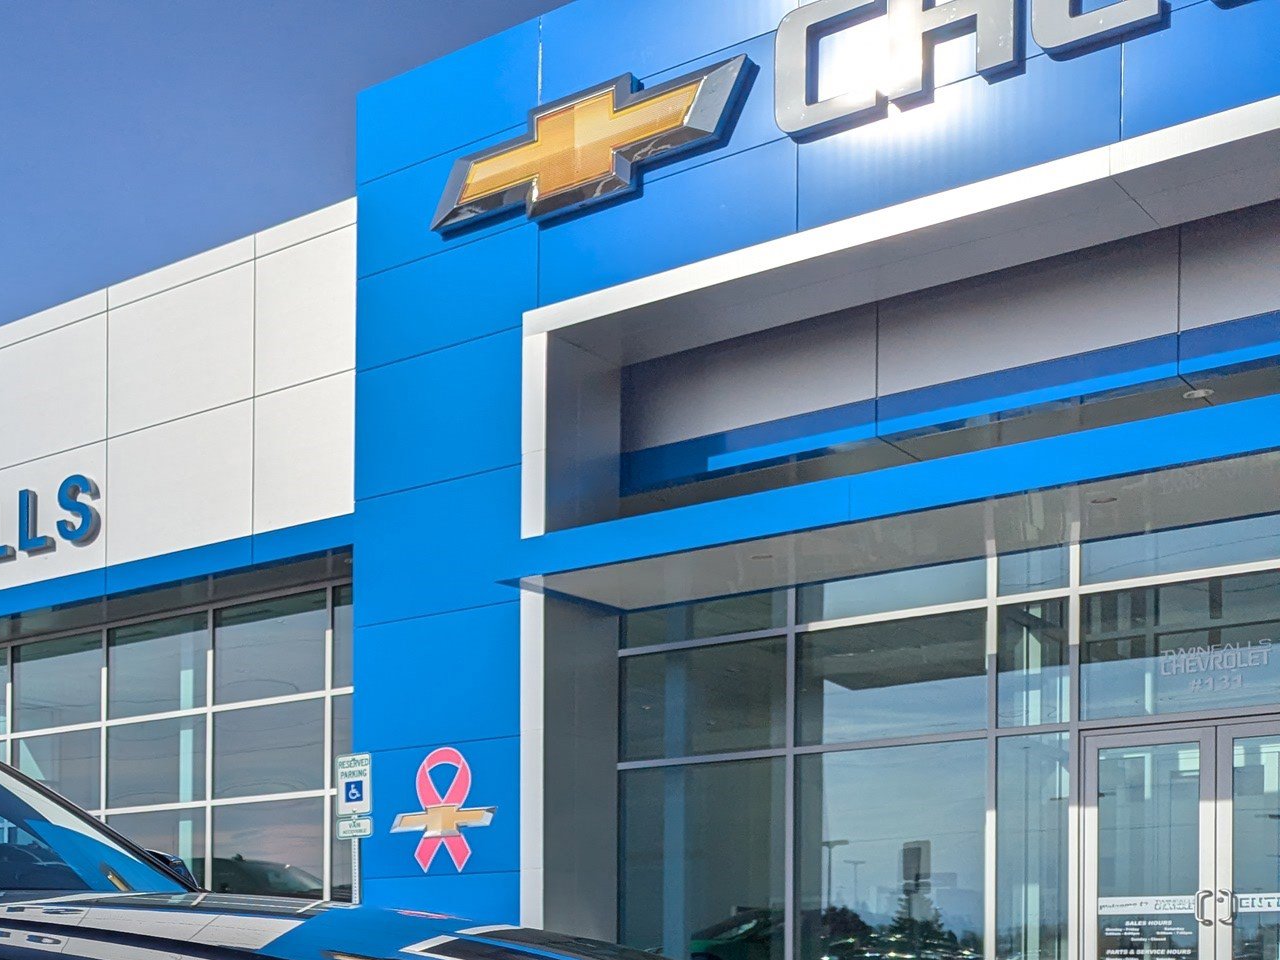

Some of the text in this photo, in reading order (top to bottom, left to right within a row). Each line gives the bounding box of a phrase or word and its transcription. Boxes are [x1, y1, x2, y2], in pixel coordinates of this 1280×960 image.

[1160, 648, 1272, 676] CHEVROLET
[1191, 674, 1243, 692] #131
[339, 758, 369, 769] RESERVED
[341, 769, 367, 779] PARKING
